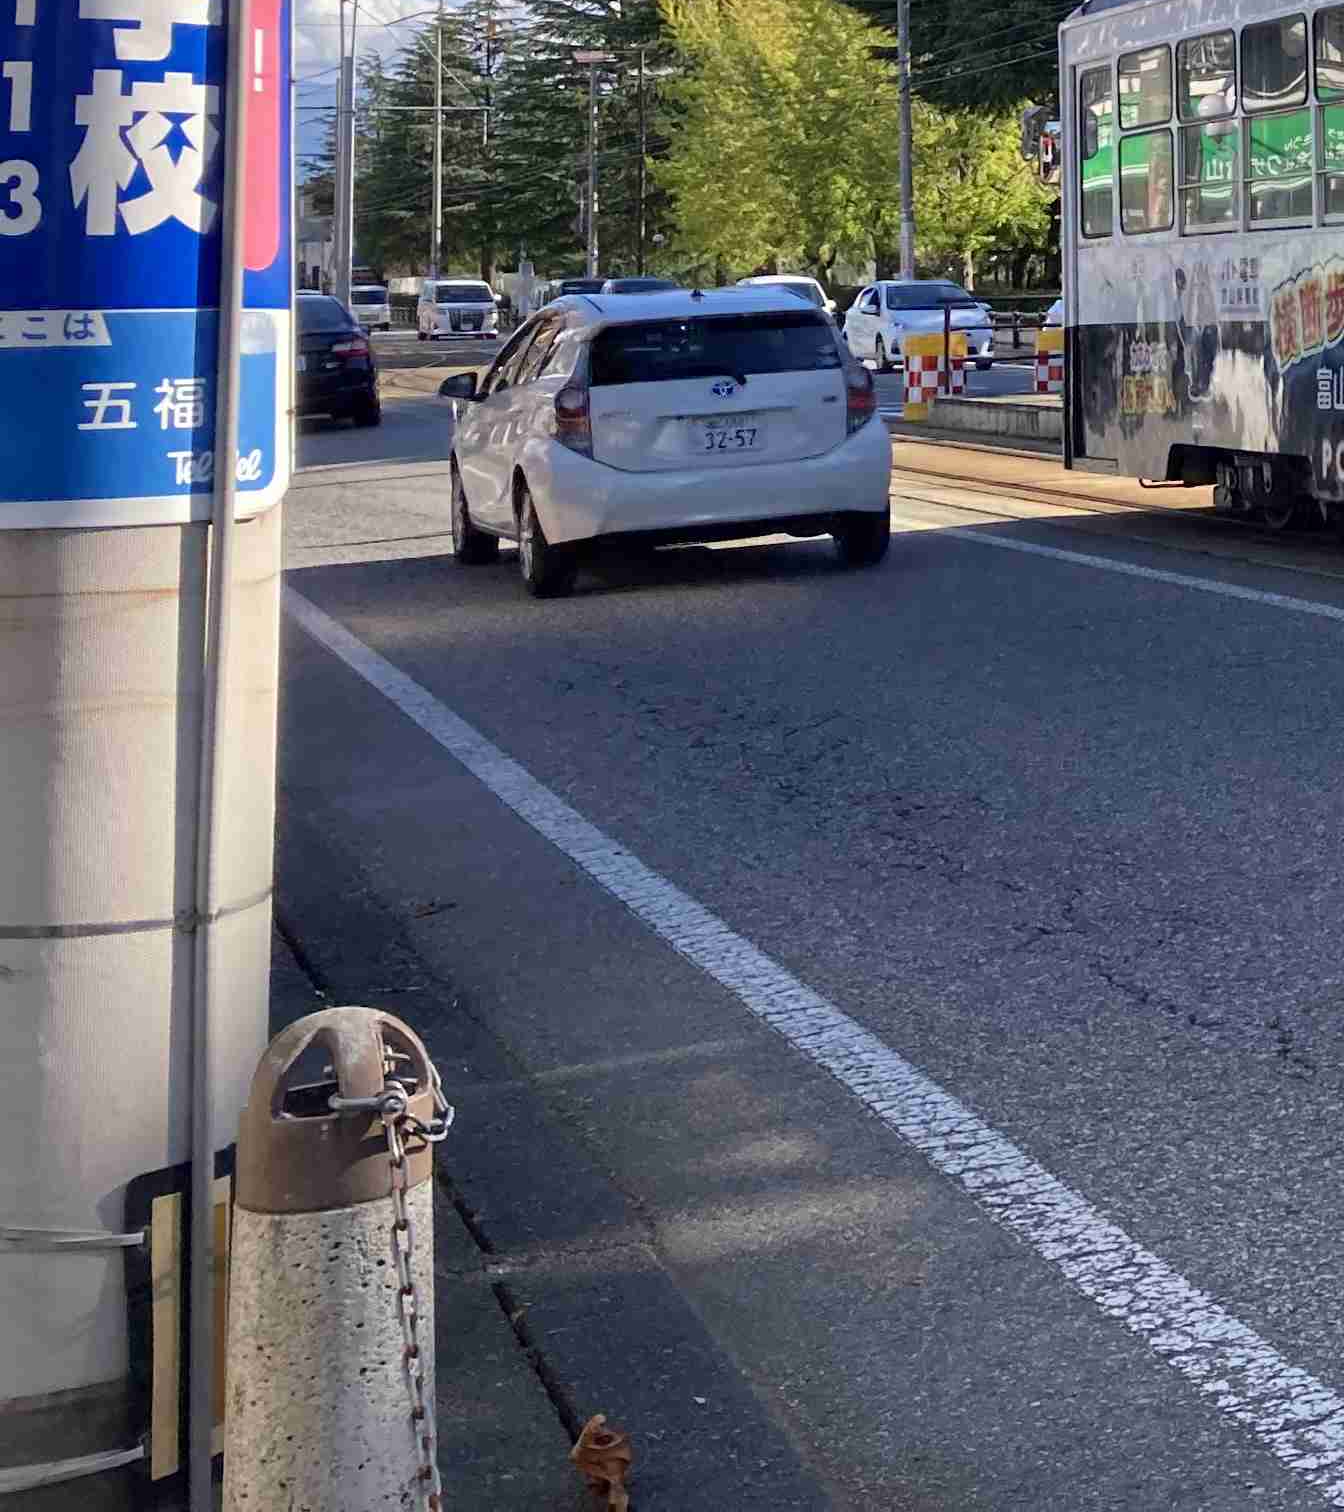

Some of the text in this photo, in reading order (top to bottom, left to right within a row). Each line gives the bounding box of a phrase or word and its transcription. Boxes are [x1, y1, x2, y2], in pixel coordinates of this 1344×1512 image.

[0, 311, 96, 341] こは
[77, 377, 206, 430] 五福
[705, 428, 758, 451] 32-57
